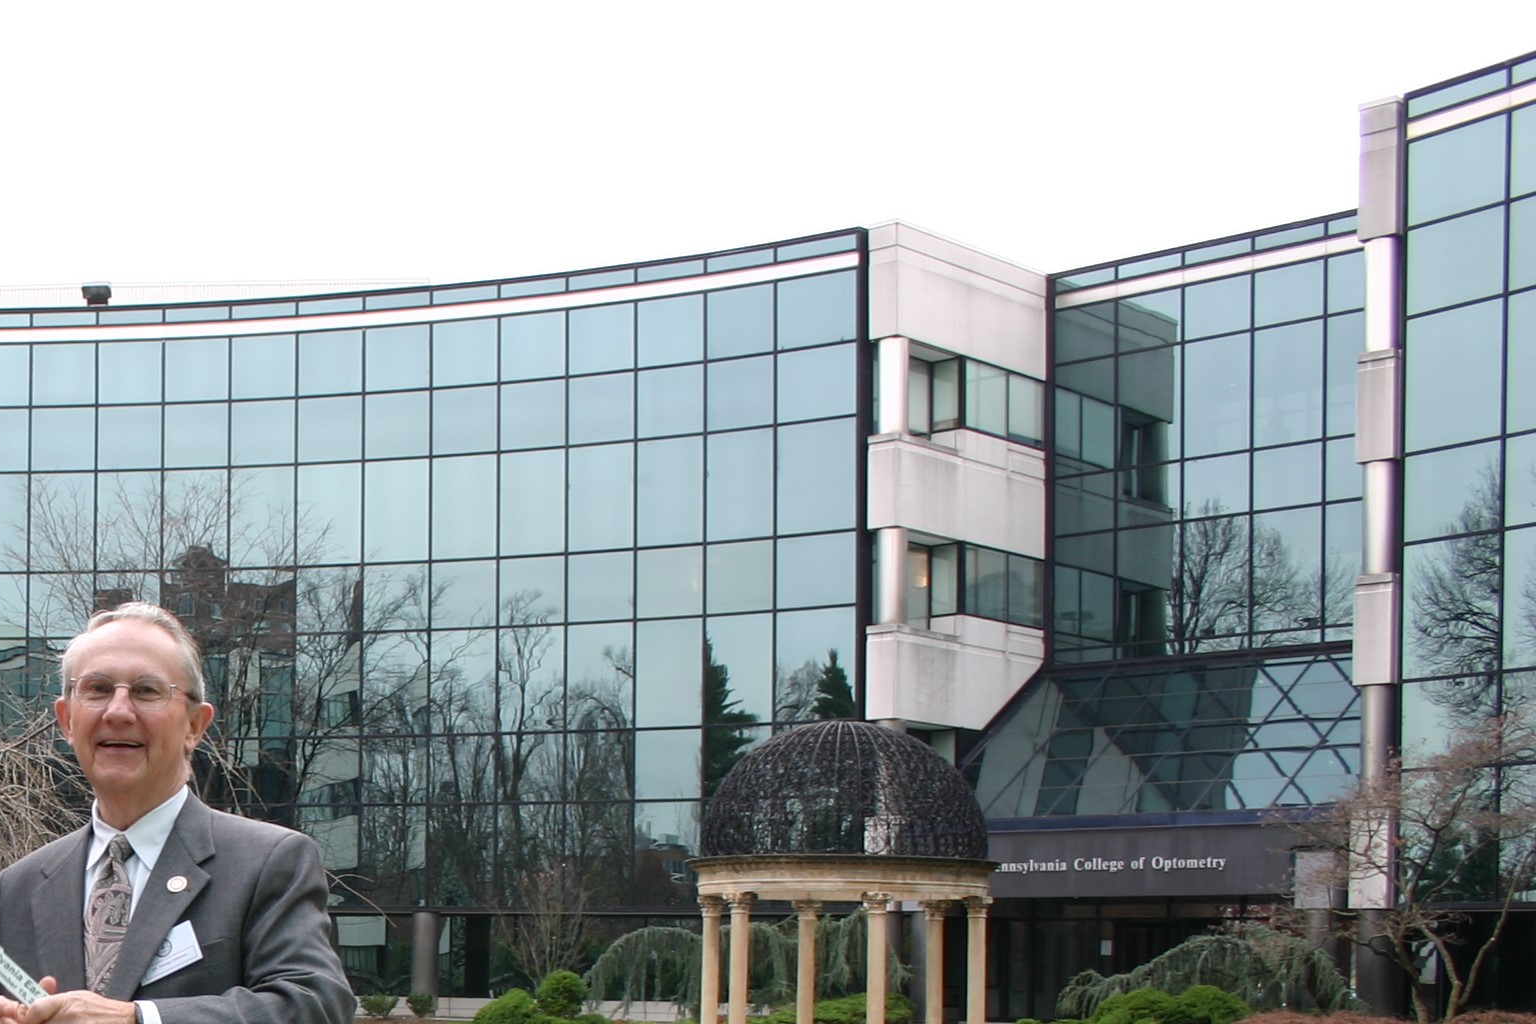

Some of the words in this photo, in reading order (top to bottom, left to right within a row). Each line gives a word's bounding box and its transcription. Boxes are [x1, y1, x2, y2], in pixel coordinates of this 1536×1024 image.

[1074, 858, 1124, 872] College
[1131, 857, 1145, 870] of
[1151, 856, 1227, 872] Optometry
[24, 980, 42, 996] Ear
